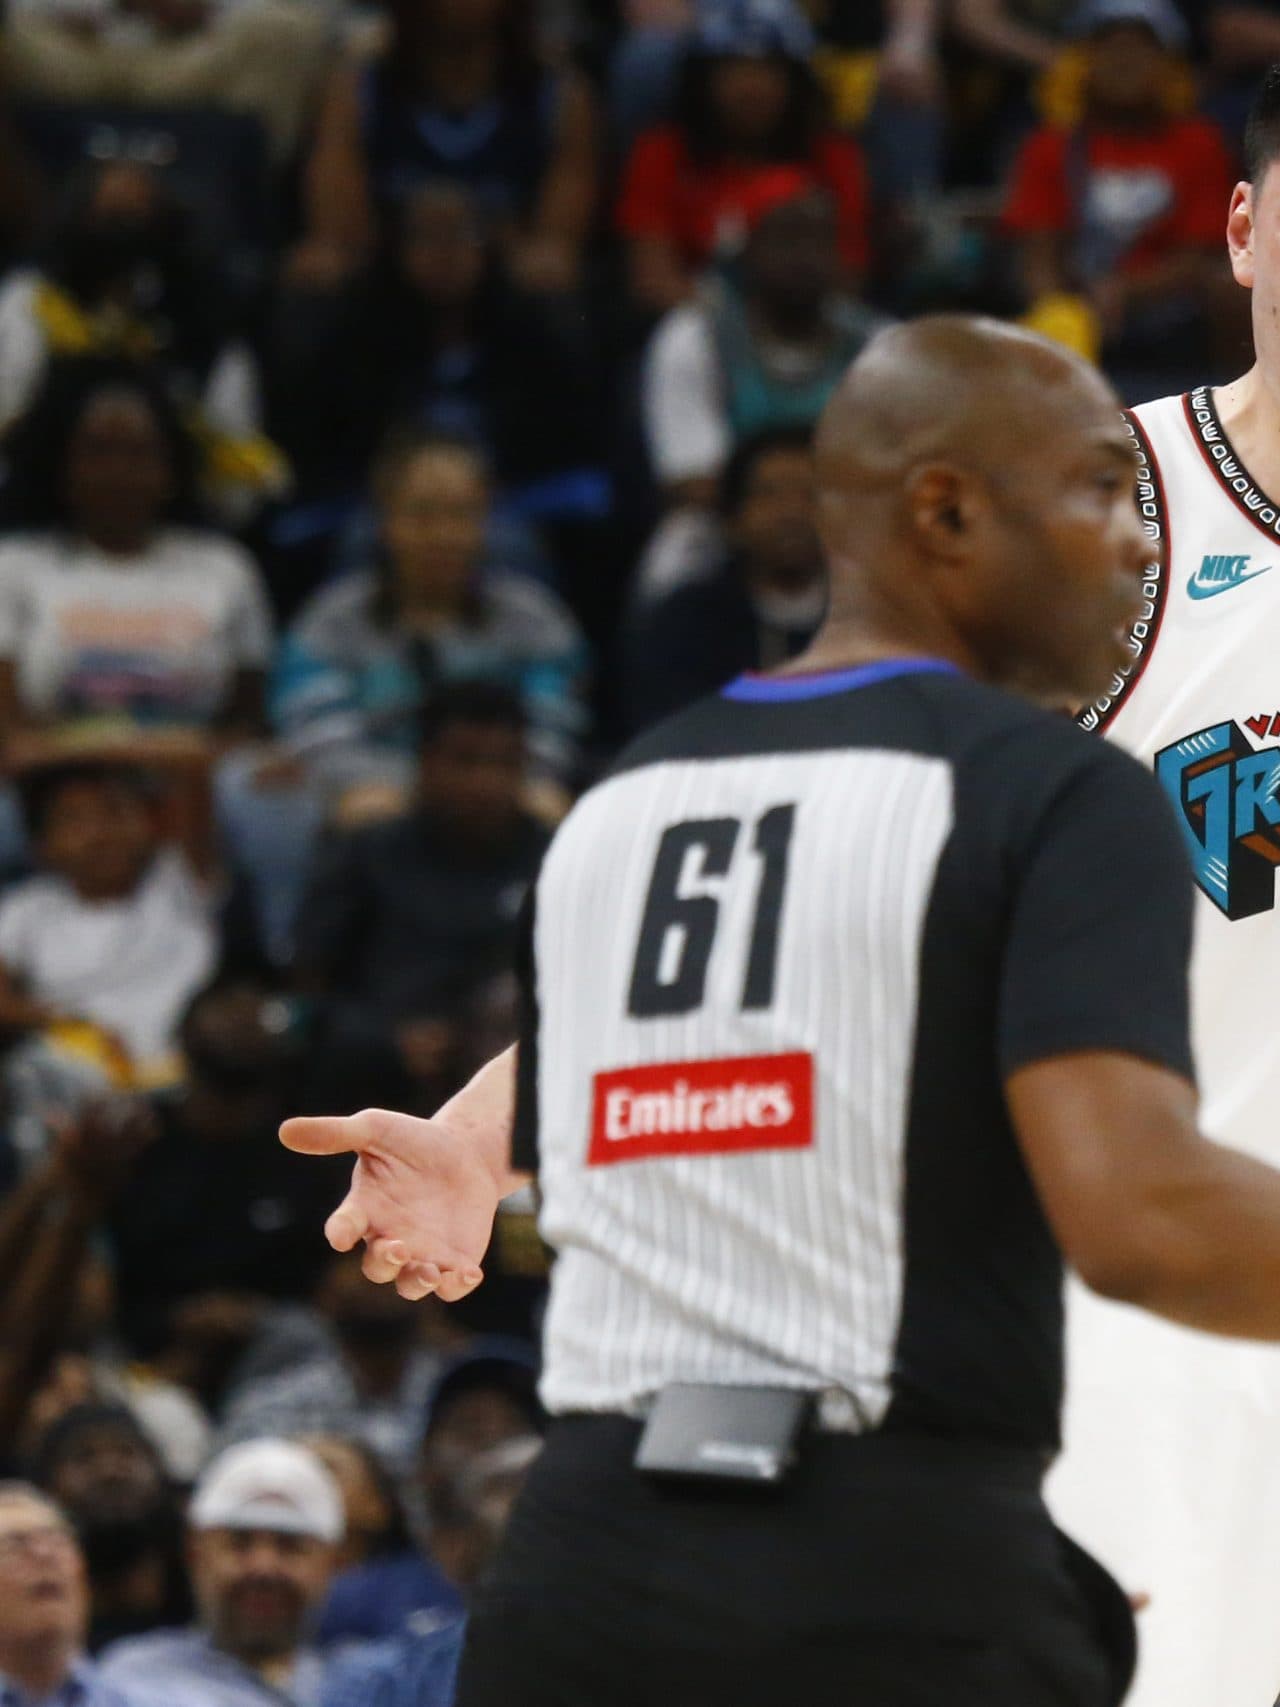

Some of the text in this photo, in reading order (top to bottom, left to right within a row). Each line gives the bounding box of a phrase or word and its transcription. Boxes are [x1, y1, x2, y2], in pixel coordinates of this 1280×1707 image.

[1198, 554, 1252, 582] NIKE
[626, 802, 796, 1020] 61
[604, 1080, 795, 1141] Emirates
